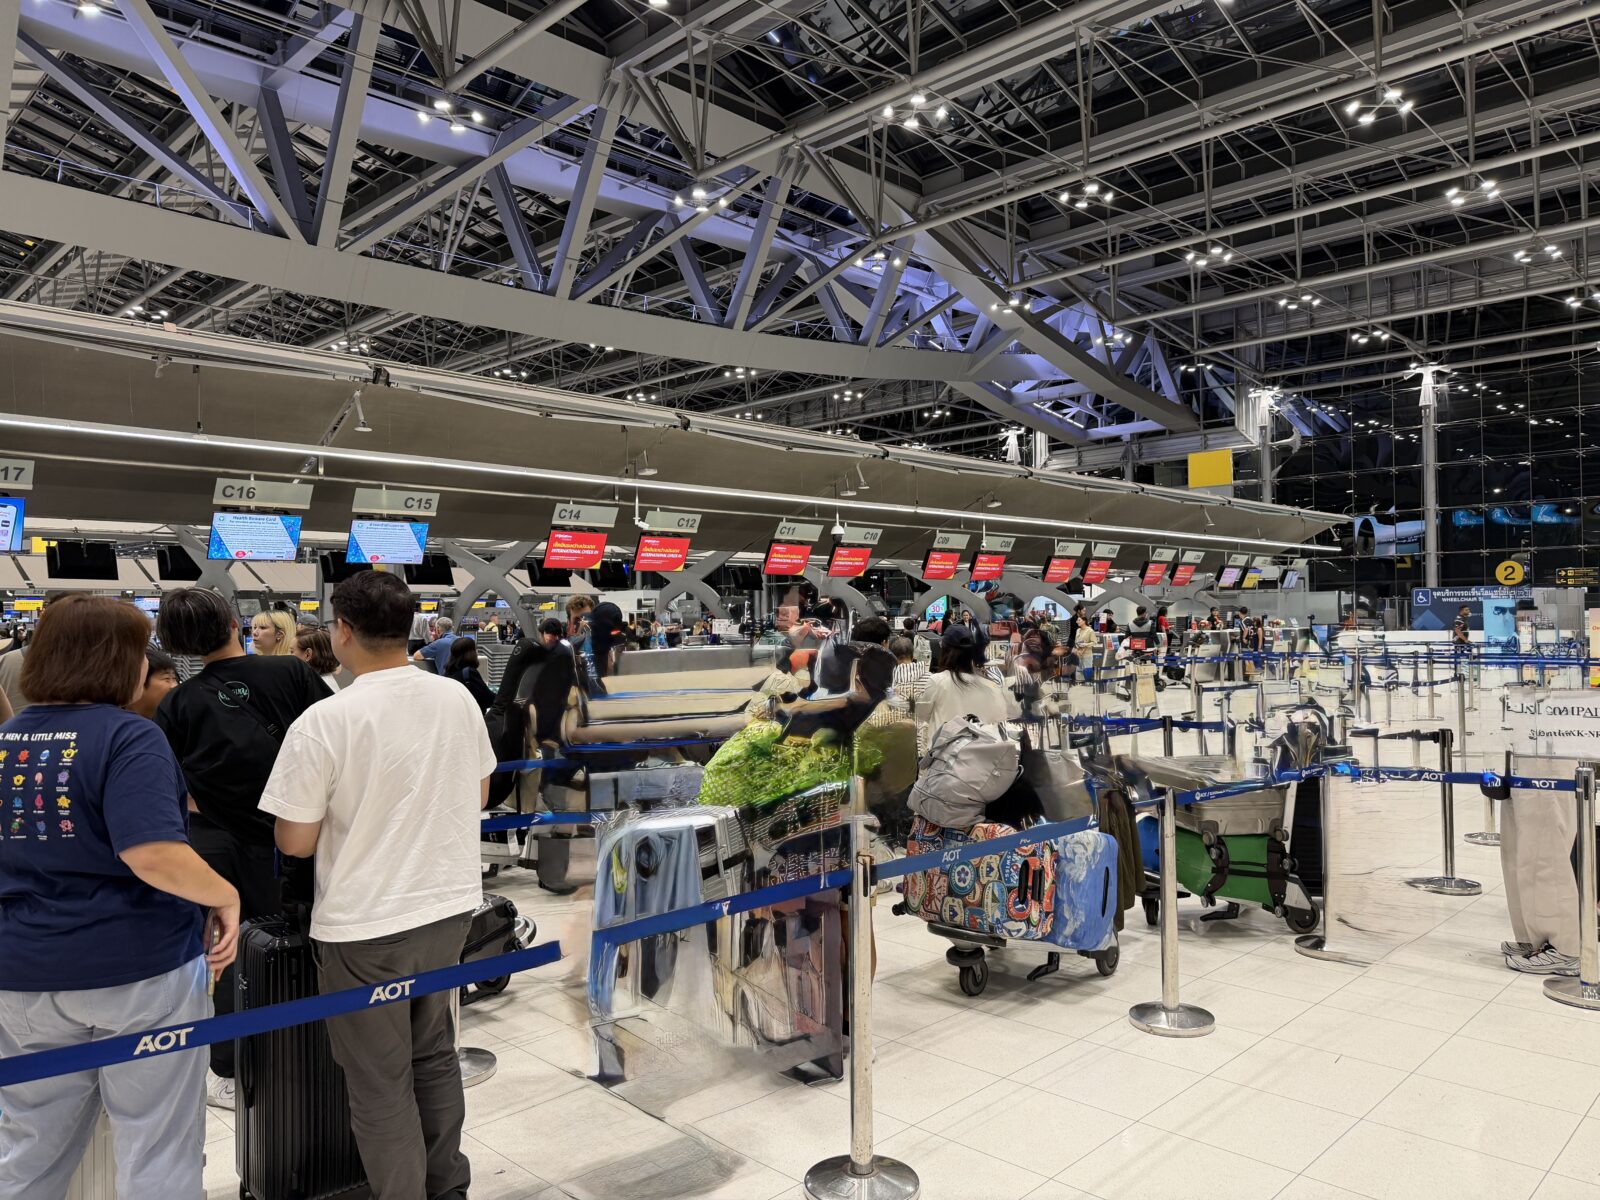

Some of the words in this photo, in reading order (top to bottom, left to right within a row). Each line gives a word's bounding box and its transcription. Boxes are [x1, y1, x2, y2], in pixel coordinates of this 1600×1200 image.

[222, 485, 256, 499] C16
[404, 497, 432, 510] C15
[558, 508, 581, 520] C14
[677, 517, 697, 528] C12
[779, 526, 796, 535] C11
[863, 532, 879, 541] C10
[1504, 565, 1516, 581] 2
[4, 732, 22, 741] MEN
[22, 733, 29, 741] &
[31, 732, 53, 741] LITTLE
[54, 731, 78, 740] MISS
[1421, 771, 1446, 781] AOT
[942, 849, 962, 863] AOT
[369, 979, 416, 1004] AOT
[133, 1026, 194, 1056] AOT
